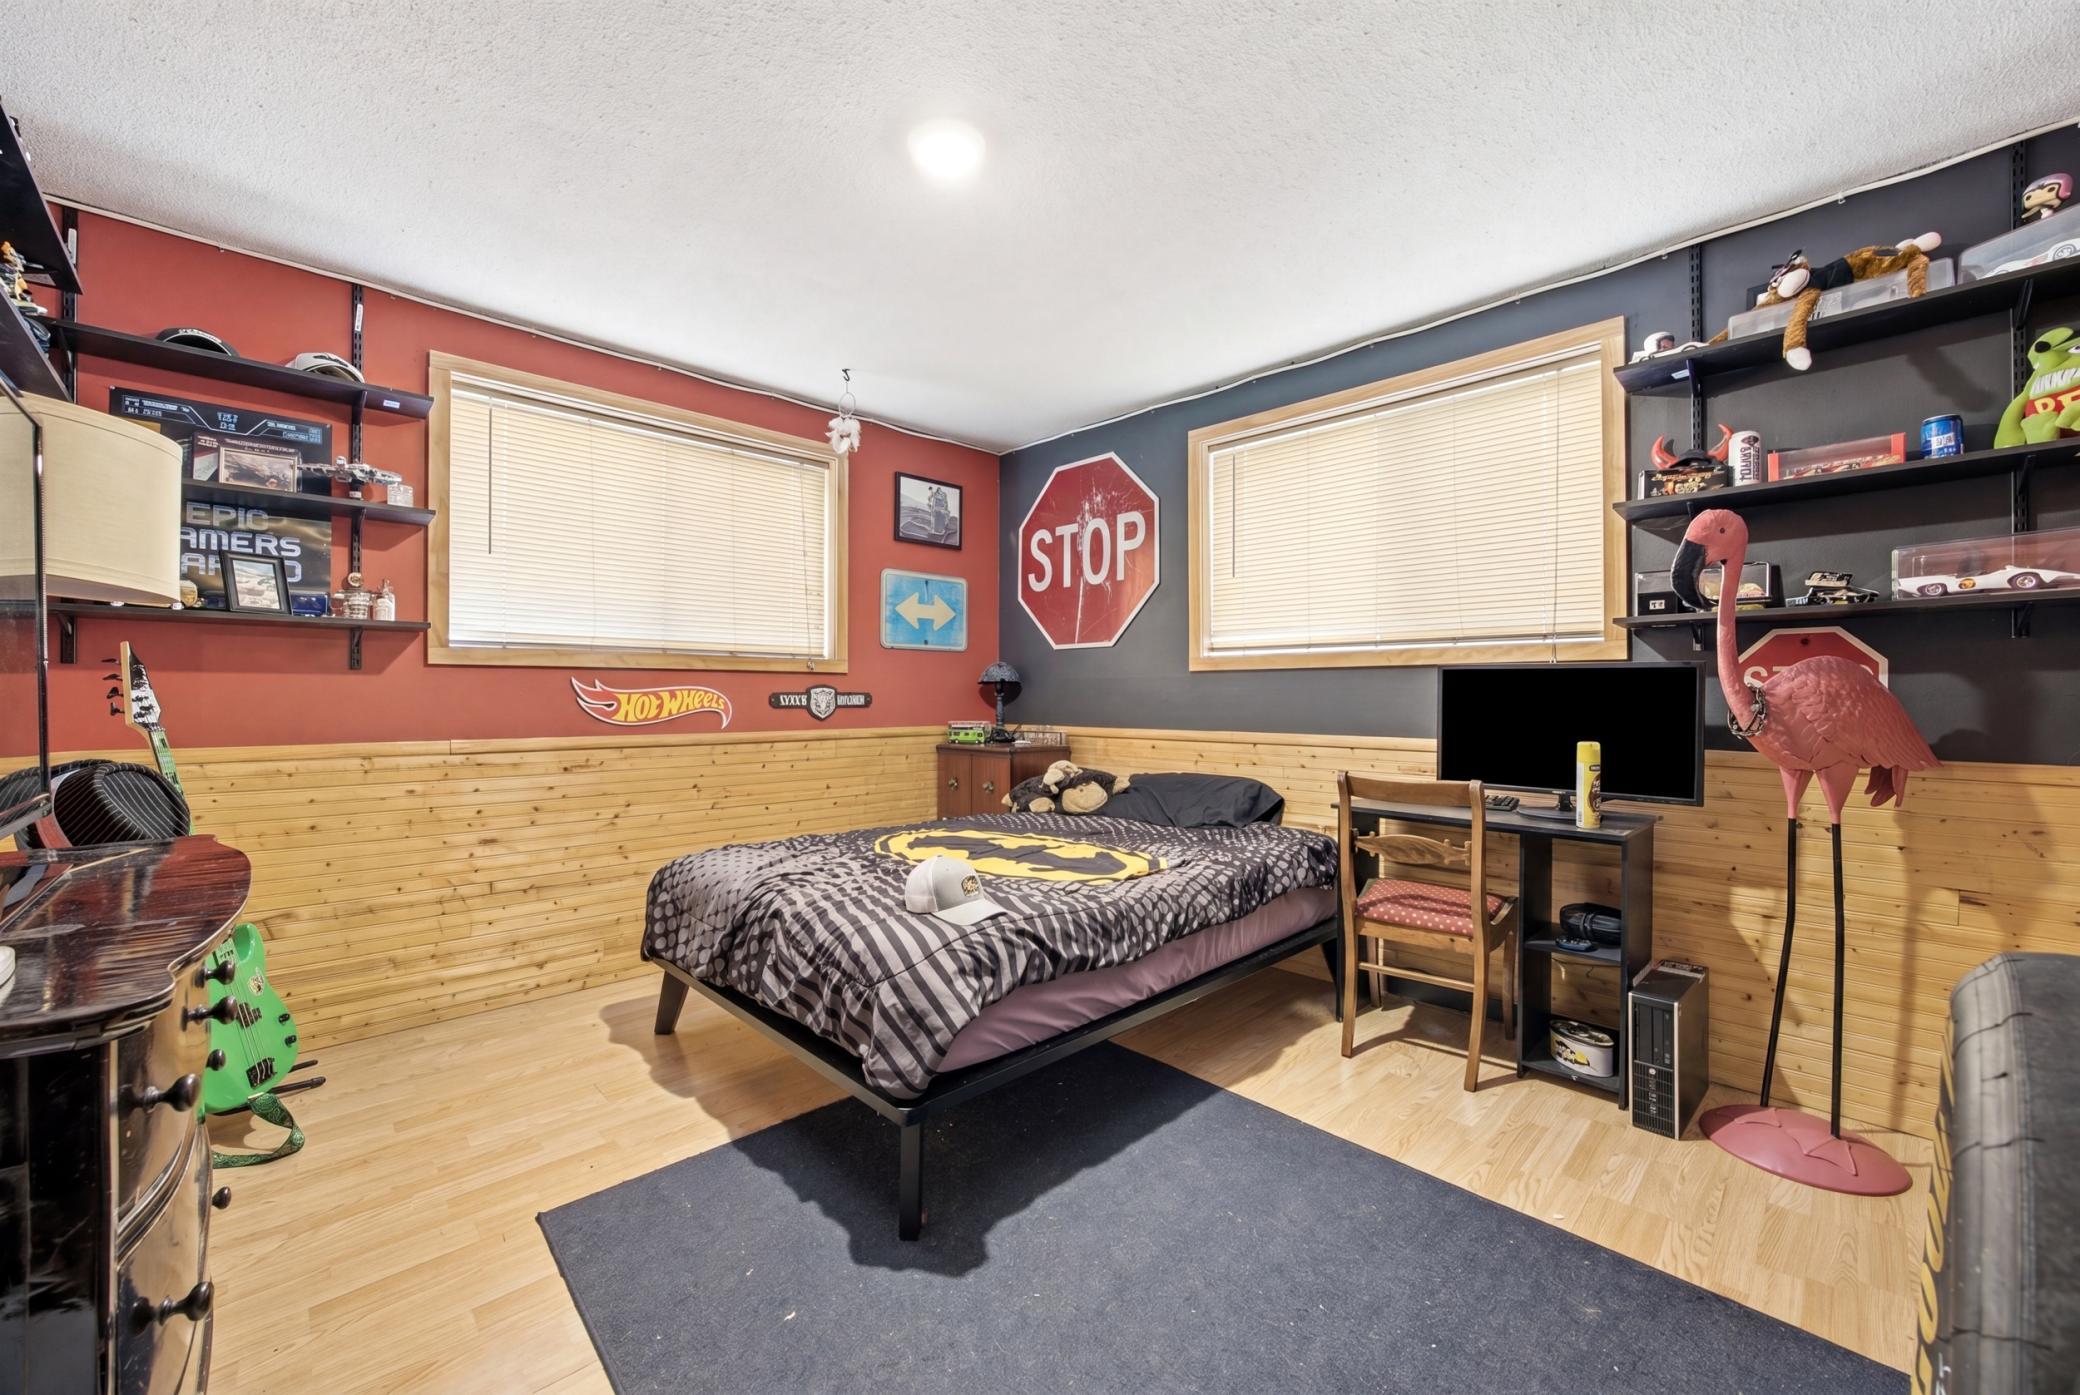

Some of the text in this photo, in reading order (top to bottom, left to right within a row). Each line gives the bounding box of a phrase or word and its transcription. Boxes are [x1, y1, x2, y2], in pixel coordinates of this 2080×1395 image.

[186, 501, 269, 531] EPIC
[180, 527, 302, 557] AMERS
[1028, 511, 1146, 592] STOP
